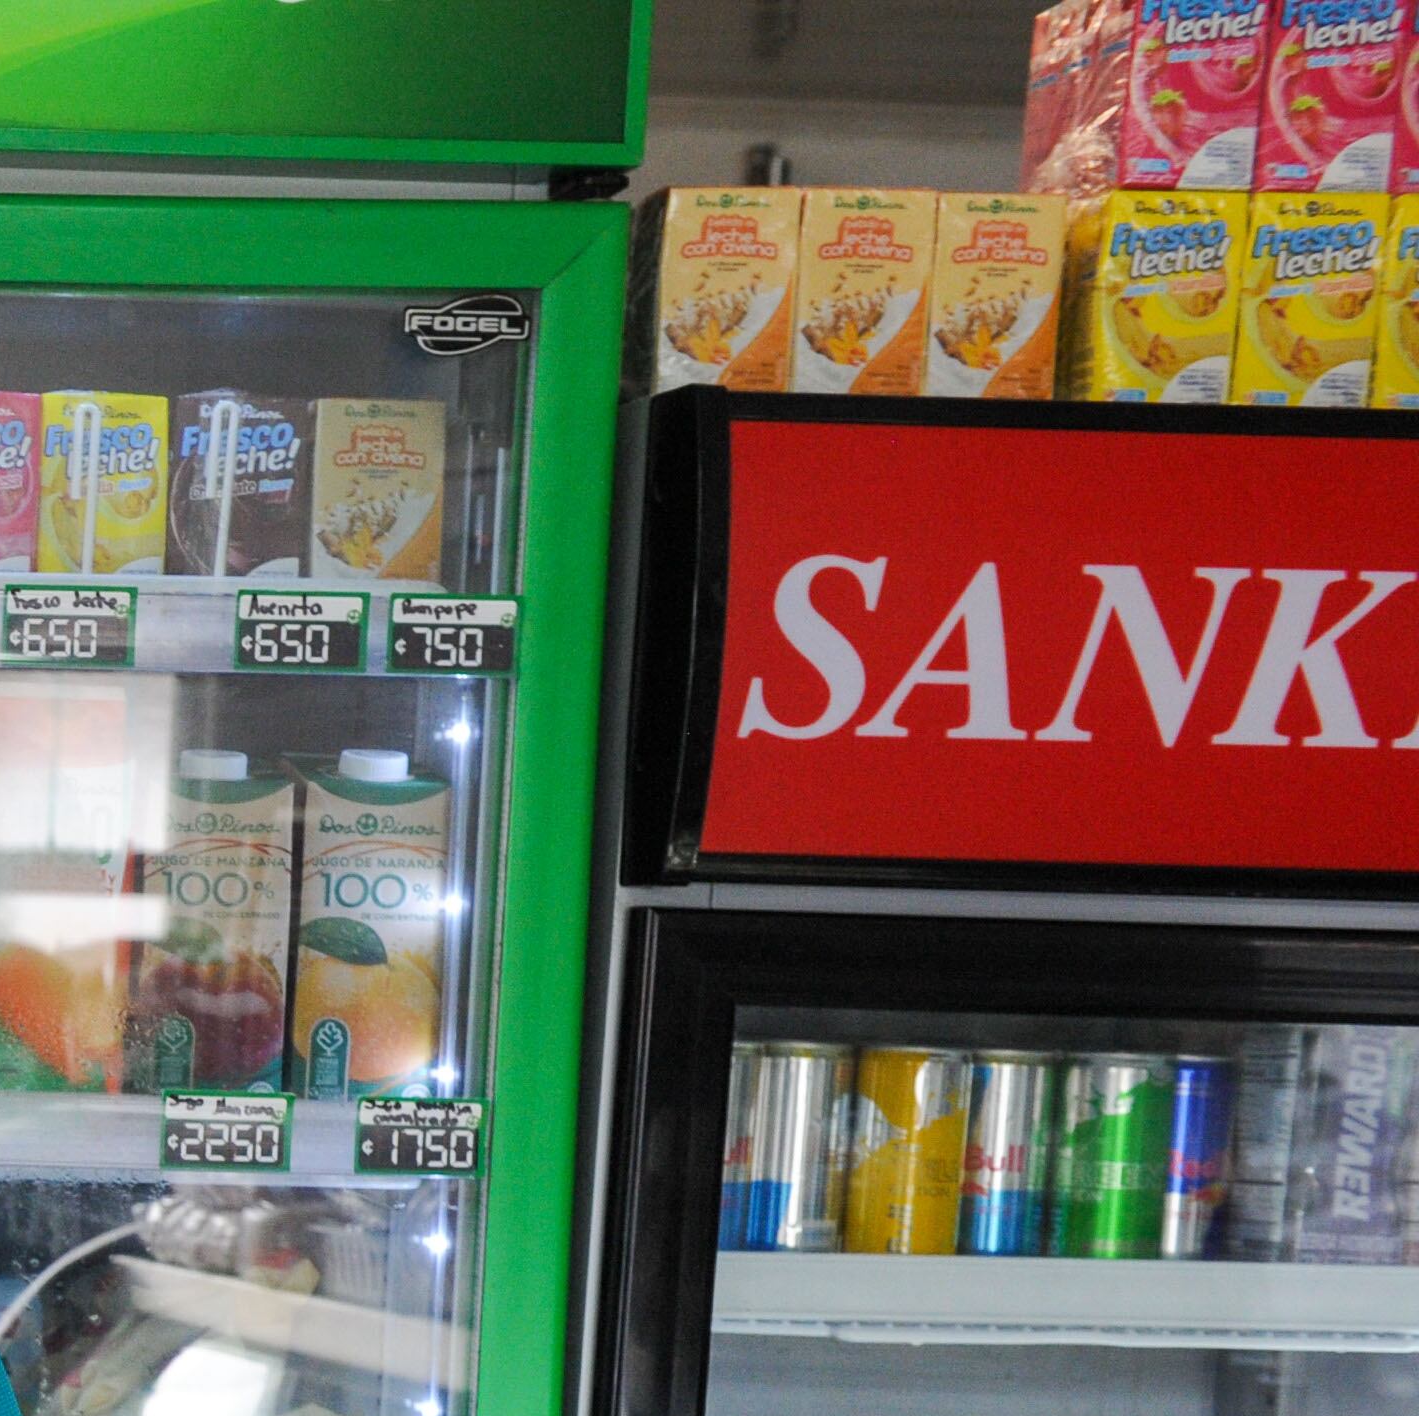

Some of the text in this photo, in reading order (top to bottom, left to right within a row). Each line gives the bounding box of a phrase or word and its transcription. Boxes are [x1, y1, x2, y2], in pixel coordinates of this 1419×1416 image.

[1165, 3, 1263, 44] leche!
[1305, 9, 1403, 49] leche!
[1110, 220, 1226, 257] Fresco
[1253, 221, 1374, 258] Fresco
[1130, 236, 1232, 279] leche!
[1275, 237, 1382, 280] leche!
[411, 316, 521, 333] FOGEL
[45, 424, 153, 457] Frsco
[9, 618, 97, 658] ¢650
[242, 624, 330, 662] ¢650
[395, 628, 483, 666] ¢750
[737, 554, 1419, 749] SANK
[221, 815, 280, 833] Pinos
[320, 815, 441, 835] Dos Pinos
[195, 856, 211, 866] DE
[217, 855, 287, 867] MANZANA
[314, 857, 444, 869] JUGO DE NARANJA
[168, 1123, 278, 1162] ¢2250
[964, 1145, 1025, 1173] Bull
